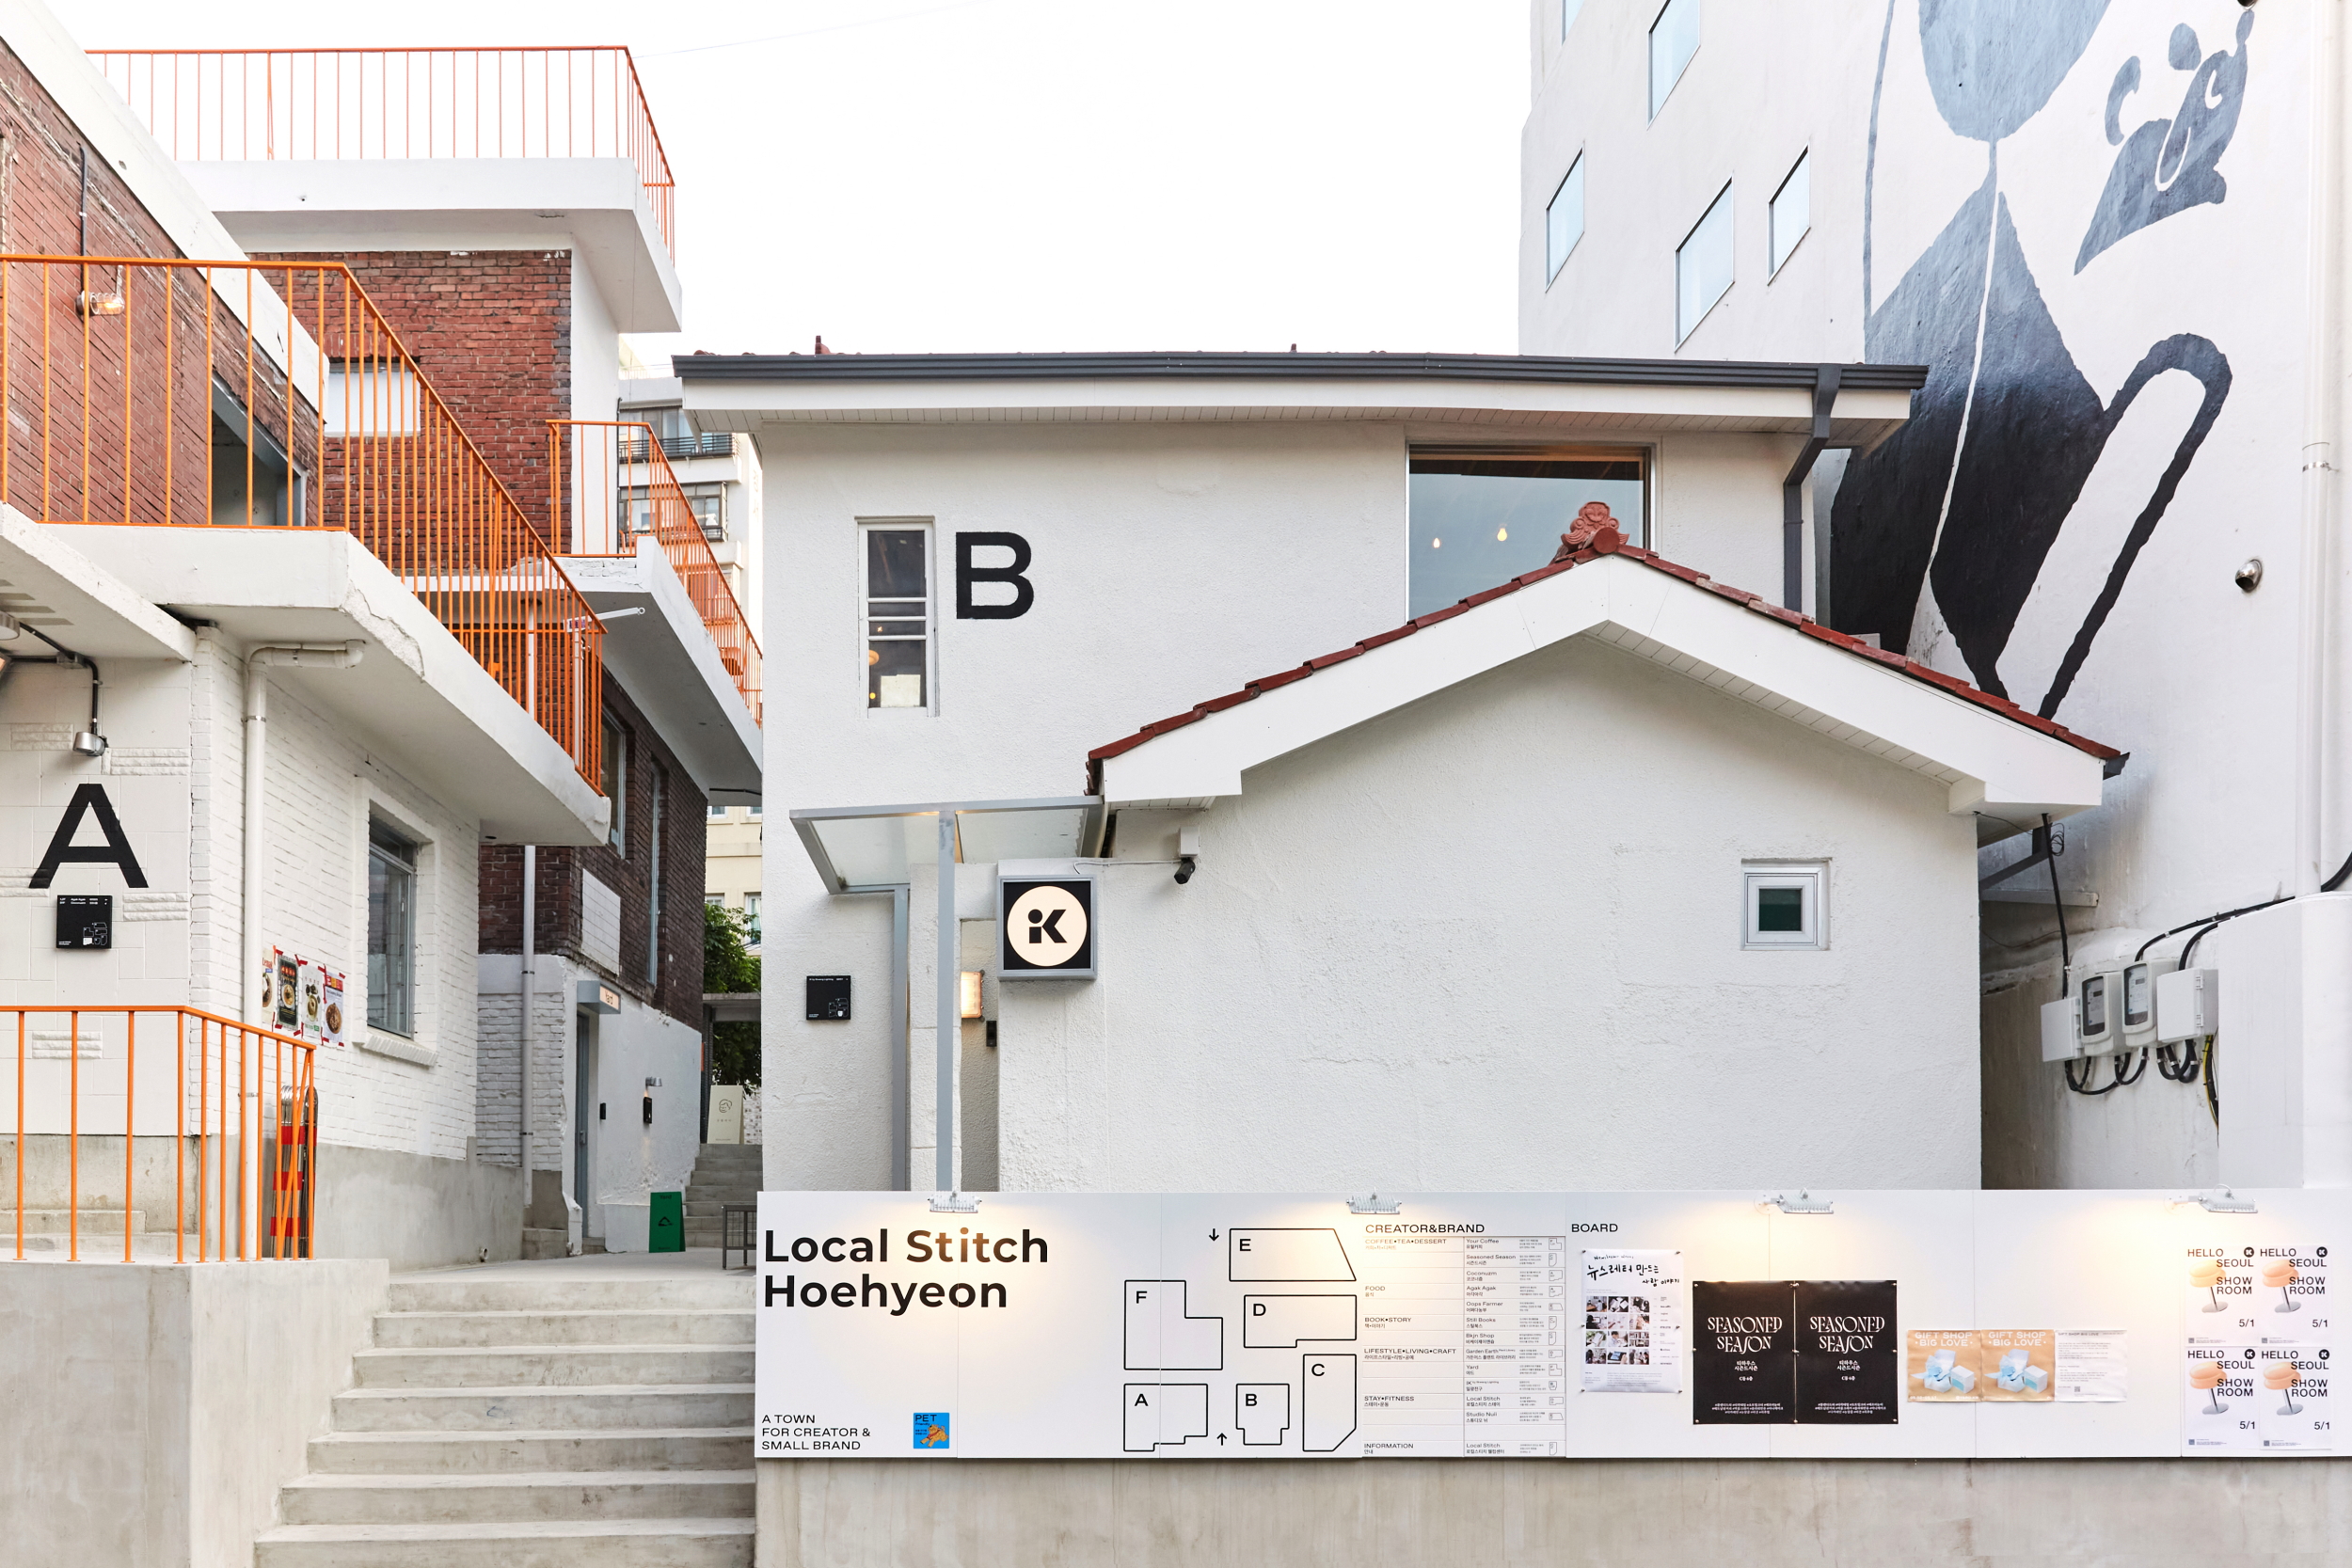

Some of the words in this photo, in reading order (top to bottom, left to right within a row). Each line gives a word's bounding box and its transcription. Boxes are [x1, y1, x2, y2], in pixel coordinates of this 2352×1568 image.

[956, 531, 1034, 620] B
[28, 784, 149, 888] A
[1366, 1225, 1485, 1233] CREATOR&BRAND
[1572, 1224, 1617, 1232] BOARD
[766, 1228, 887, 1262] Local
[907, 1227, 1047, 1262] Stitch
[1240, 1239, 1251, 1251] E
[2188, 1248, 2223, 1257] HELLO
[2260, 1248, 2296, 1257] HELLO
[2217, 1259, 2254, 1267] SEOUL
[2289, 1259, 2327, 1267] SEOUL
[1587, 1264, 1632, 1280] 뉴스레터
[1636, 1264, 1659, 1275] 만드는
[2217, 1276, 2252, 1285] SHOW
[2289, 1276, 2326, 1285] SHOW
[2217, 1286, 2252, 1294] ROOM
[2290, 1286, 2326, 1294] ROOM
[765, 1274, 1006, 1316] Hoehyeon
[1136, 1291, 1147, 1304] F
[1253, 1304, 1266, 1316] D
[1708, 1317, 1782, 1333] SEASONED
[1810, 1317, 1884, 1332] SEASONED
[2239, 1319, 2254, 1327] 5/1
[2312, 1319, 2328, 1328] 5/1
[1717, 1337, 1772, 1354] SEASON
[1820, 1336, 1873, 1354] SEASON
[2262, 1351, 2298, 1359] HELLO
[1311, 1364, 1325, 1376] C
[2217, 1361, 2254, 1370] SEOUL
[2291, 1361, 2328, 1370] SEOUL
[2217, 1379, 2253, 1387] SHOW
[2291, 1379, 2328, 1387] SHOW
[2217, 1388, 2253, 1397] ROOM
[1135, 1394, 1148, 1406] A
[1246, 1394, 1257, 1406] B
[762, 1415, 771, 1423] A
[774, 1415, 815, 1423] TOWN
[2239, 1421, 2255, 1430] 5/1
[2314, 1421, 2329, 1431] 5/1
[763, 1428, 788, 1436] FOR
[794, 1428, 857, 1436] CREATOR
[863, 1428, 870, 1436] &
[762, 1441, 809, 1449] SMALL
[814, 1441, 860, 1449] BRAND
